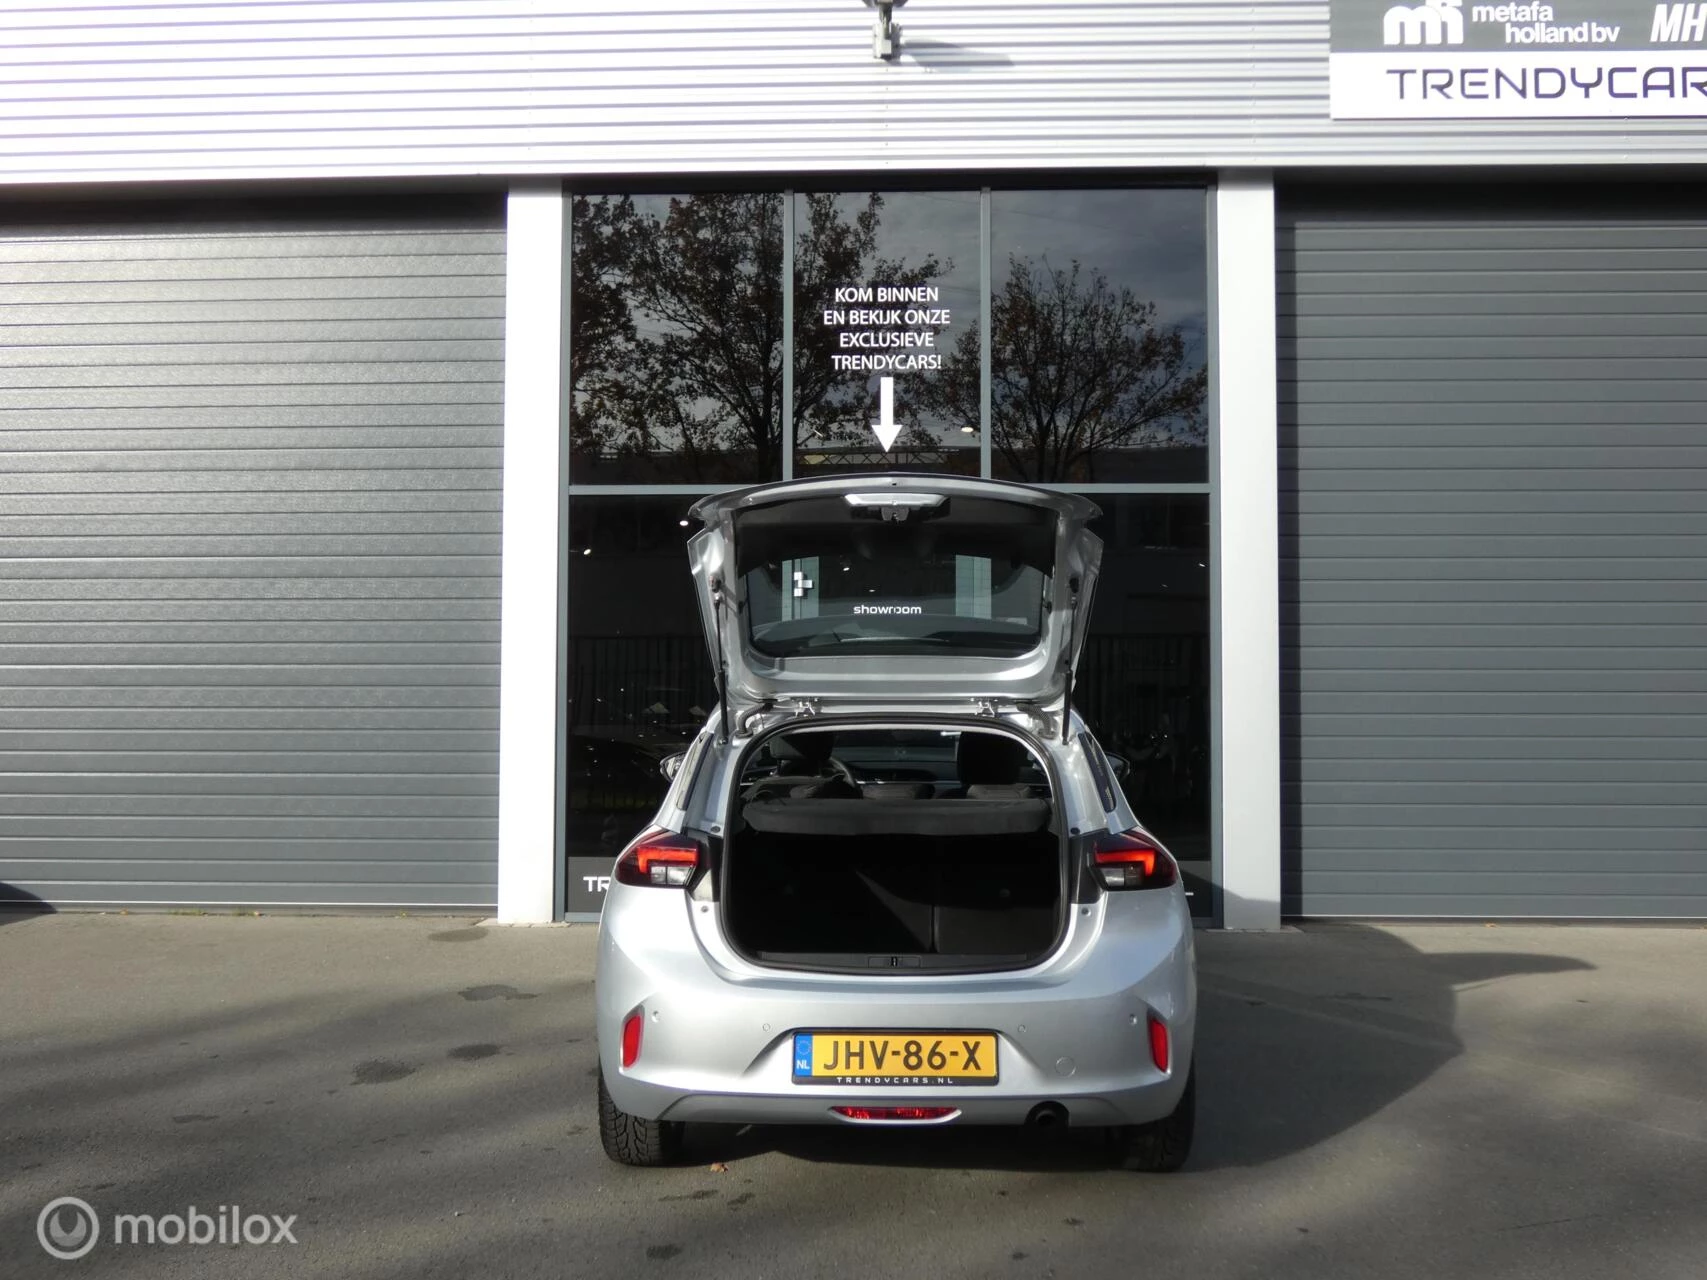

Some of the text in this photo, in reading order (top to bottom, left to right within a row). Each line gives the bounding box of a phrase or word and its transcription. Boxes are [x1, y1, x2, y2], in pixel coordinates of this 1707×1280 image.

[1472, 1, 1553, 22] metafa
[835, 287, 939, 303] KOM BINNEN
[823, 309, 951, 325] EN BEKIJK ONZE
[839, 332, 934, 348] EXCLUSIEVE
[831, 354, 942, 370] TRENDYCARS!
[853, 604, 922, 615] showroom
[796, 1040, 982, 1071] NL JHV-86-X
[836, 1076, 953, 1084] TRENDYCARS.NL
